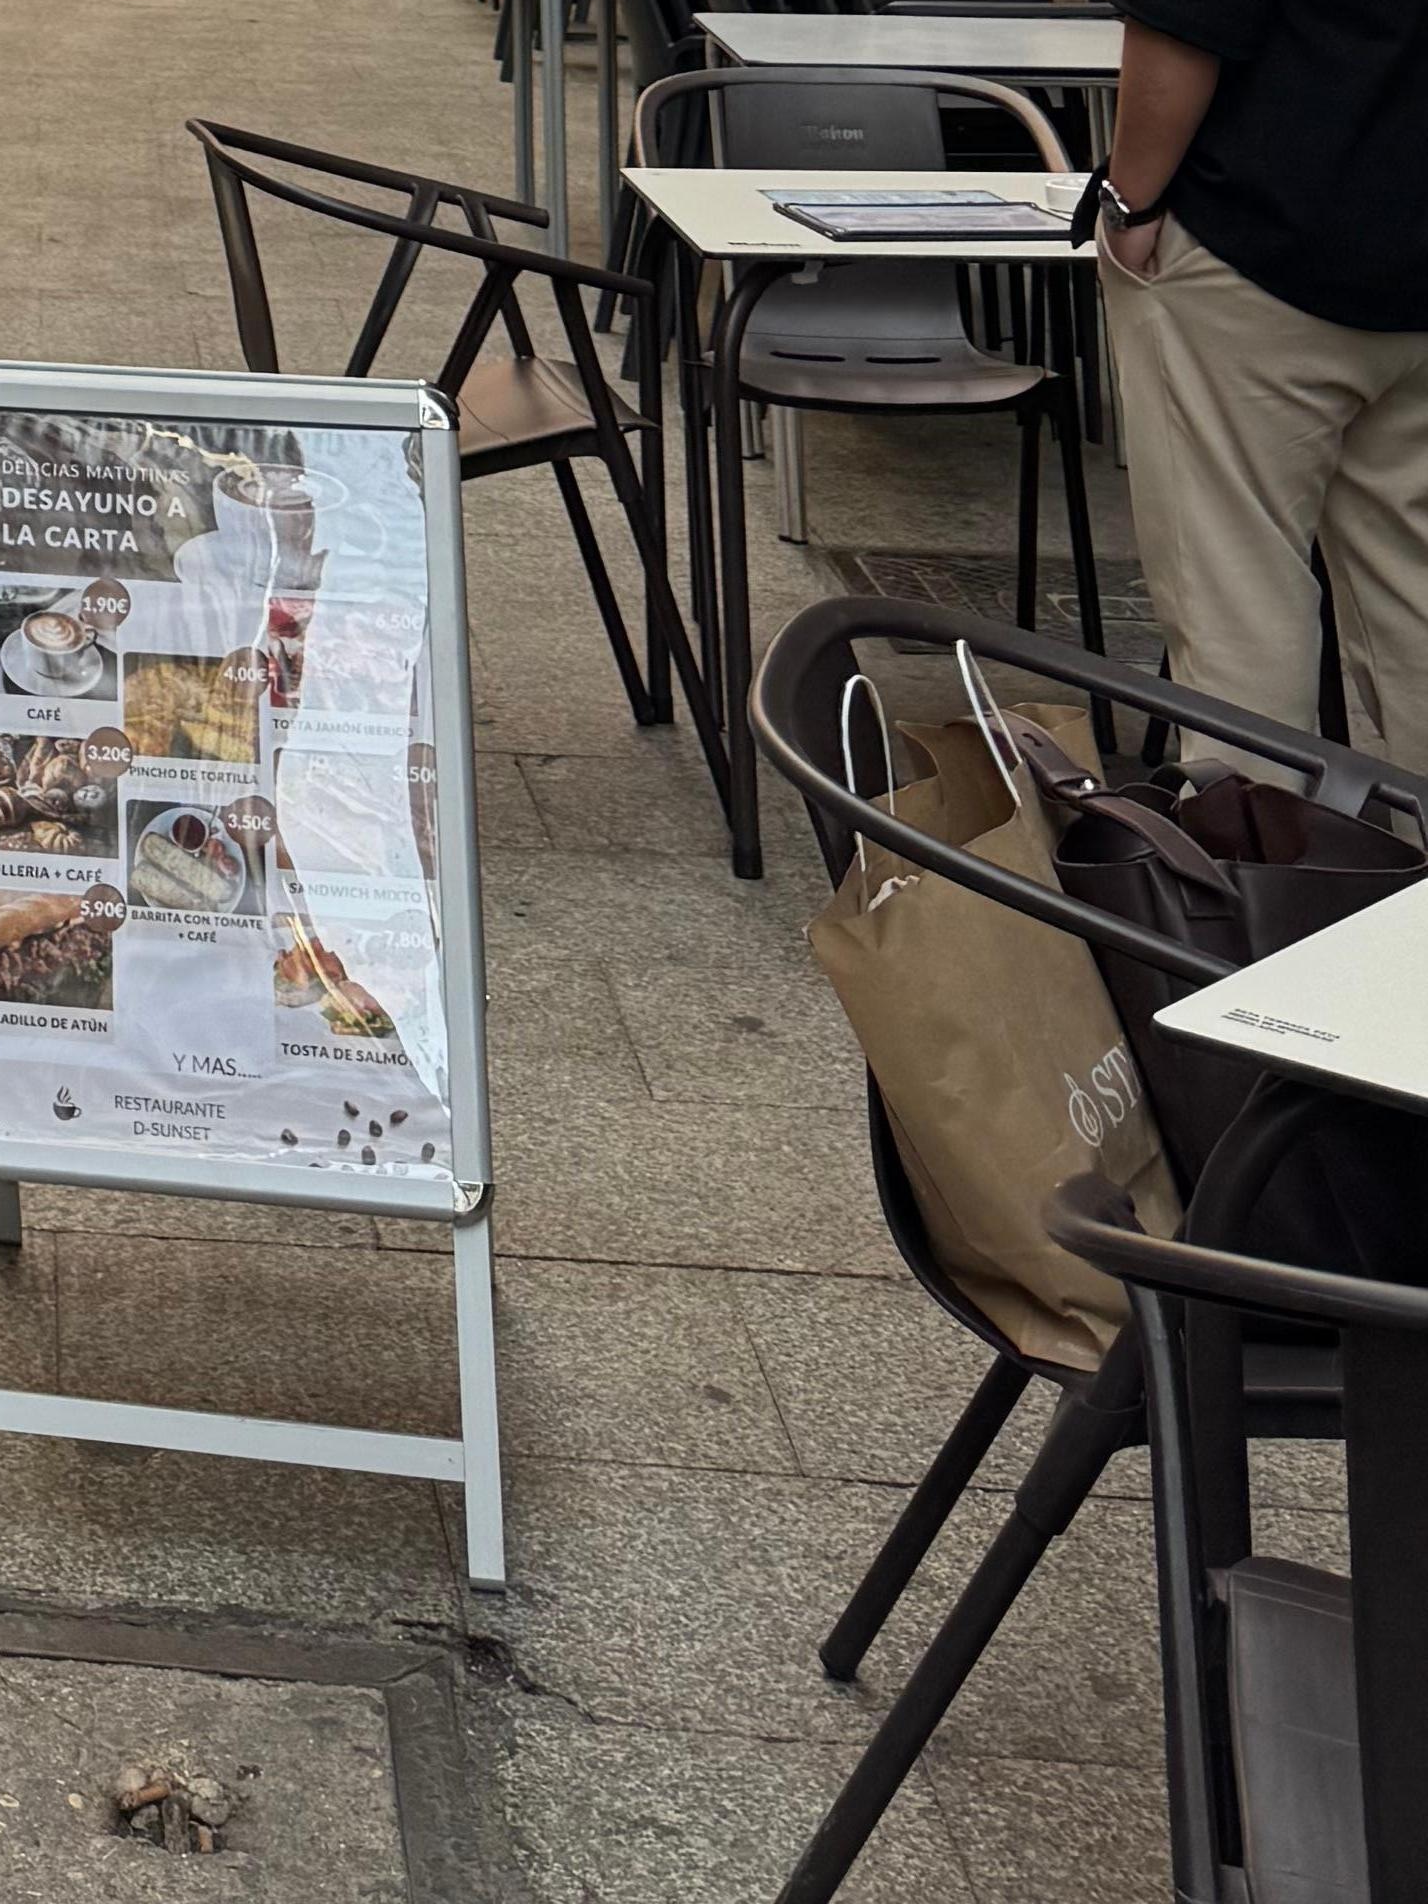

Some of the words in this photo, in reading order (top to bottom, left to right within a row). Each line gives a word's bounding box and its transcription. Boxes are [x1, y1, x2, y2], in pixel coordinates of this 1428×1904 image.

[2, 459, 80, 479] DELICIAS
[86, 463, 190, 485] MATUTINAS
[1, 487, 158, 516] DESAYUNO
[166, 497, 187, 519] A
[2, 523, 36, 547] LA
[44, 526, 139, 553] CARTA
[27, 705, 62, 722] CAFÉ
[128, 764, 177, 781] PINCHO
[181, 768, 196, 782] DE
[198, 769, 259, 786] TORTILLA
[65, 865, 103, 884] CAFÉ
[131, 909, 180, 926] BARRITA
[183, 913, 210, 928] CON
[214, 915, 263, 931] TOMATE
[190, 927, 217, 944] CAFÉ
[51, 1016, 67, 1030] DE
[172, 1053, 185, 1072] Y
[281, 1042, 330, 1061] TOSTA
[333, 1045, 353, 1062] DE
[114, 1094, 226, 1121] RESTAURANTE
[133, 1121, 212, 1142] D-SUNSET
